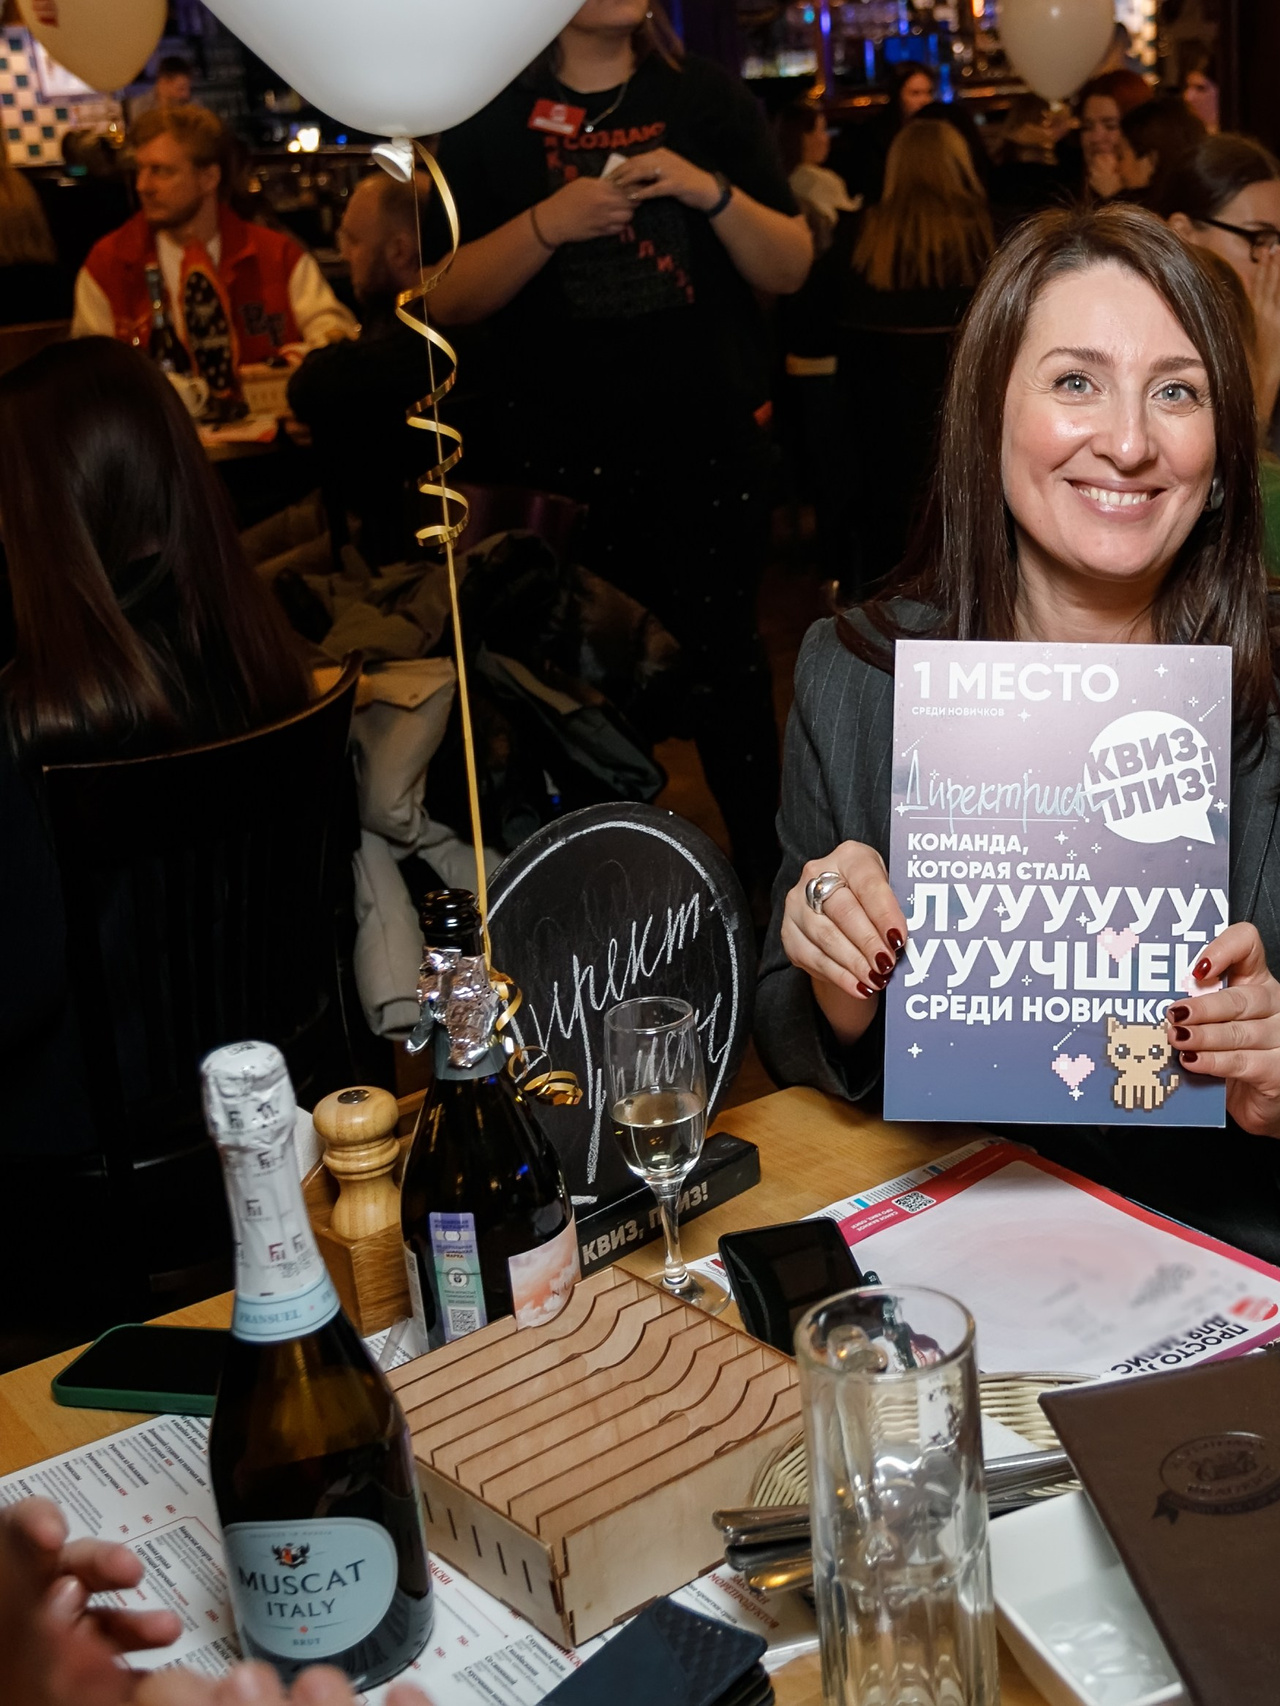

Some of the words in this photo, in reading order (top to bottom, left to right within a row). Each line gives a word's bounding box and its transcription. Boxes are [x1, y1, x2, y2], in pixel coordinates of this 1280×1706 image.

[563, 121, 667, 150] СОЗДАЮ
[912, 661, 931, 699] 1
[949, 661, 1120, 702] МЕСТО
[911, 706, 946, 717] СРЕДИ
[948, 706, 1005, 717] НОВИЧКОВ
[1089, 727, 1214, 784] КВИЗ,
[1097, 763, 1217, 823] ПЛИЗ!
[907, 833, 1029, 855] КОМАНДА,
[906, 860, 1011, 880] КОТОРАЯ
[1016, 863, 1091, 881] СТАЛА
[905, 993, 1013, 1025] СРЕДИ
[1022, 996, 1175, 1024] НОВИЧКО
[582, 1219, 644, 1266] КВИЗ,
[649, 1181, 708, 1229] ПИЗ!
[1159, 1322, 1248, 1365] ПРОСТО
[239, 1559, 365, 1595] MUSCAT
[267, 1598, 335, 1618] ITALY
[292, 1637, 321, 1646] BRUT
